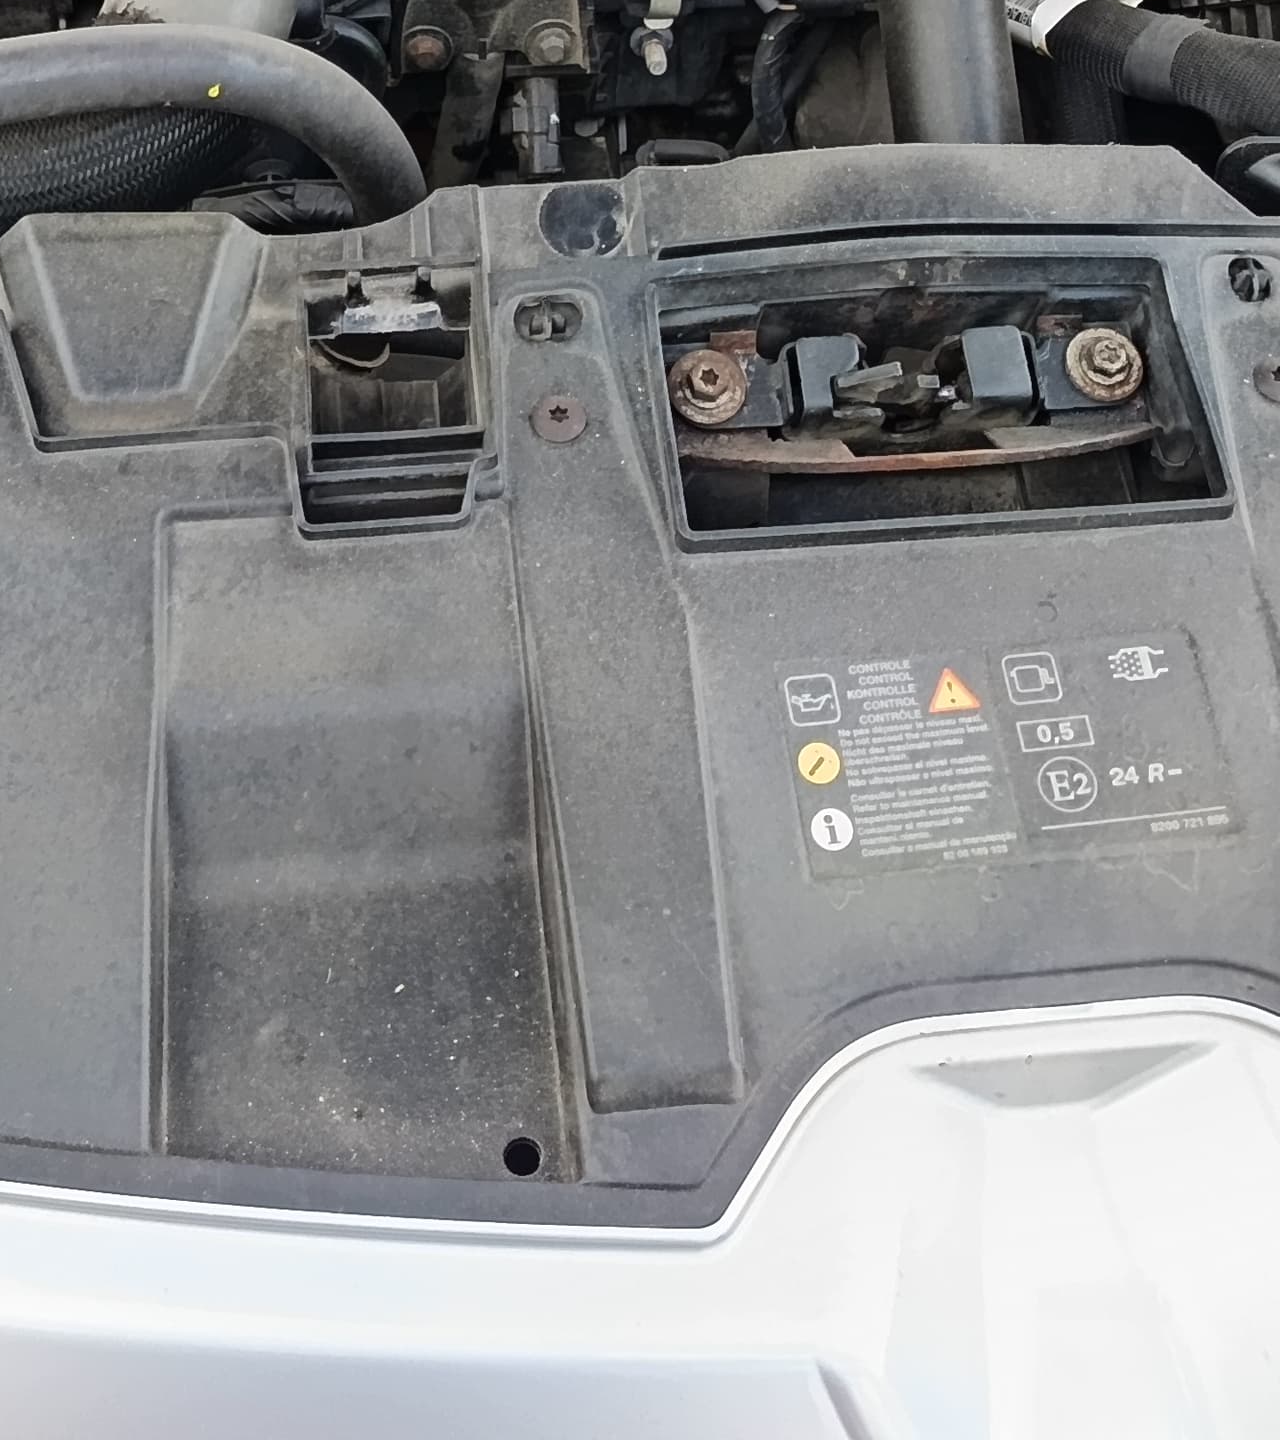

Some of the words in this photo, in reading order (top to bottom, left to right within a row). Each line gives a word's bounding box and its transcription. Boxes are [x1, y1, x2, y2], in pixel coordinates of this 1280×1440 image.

[858, 671, 914, 686] CONTROL
[846, 683, 917, 700] KONTROLLE
[863, 696, 919, 711] CONTROL
[1036, 722, 1074, 744] 0,5
[1108, 766, 1140, 786] 24
[1046, 770, 1092, 802] E2
